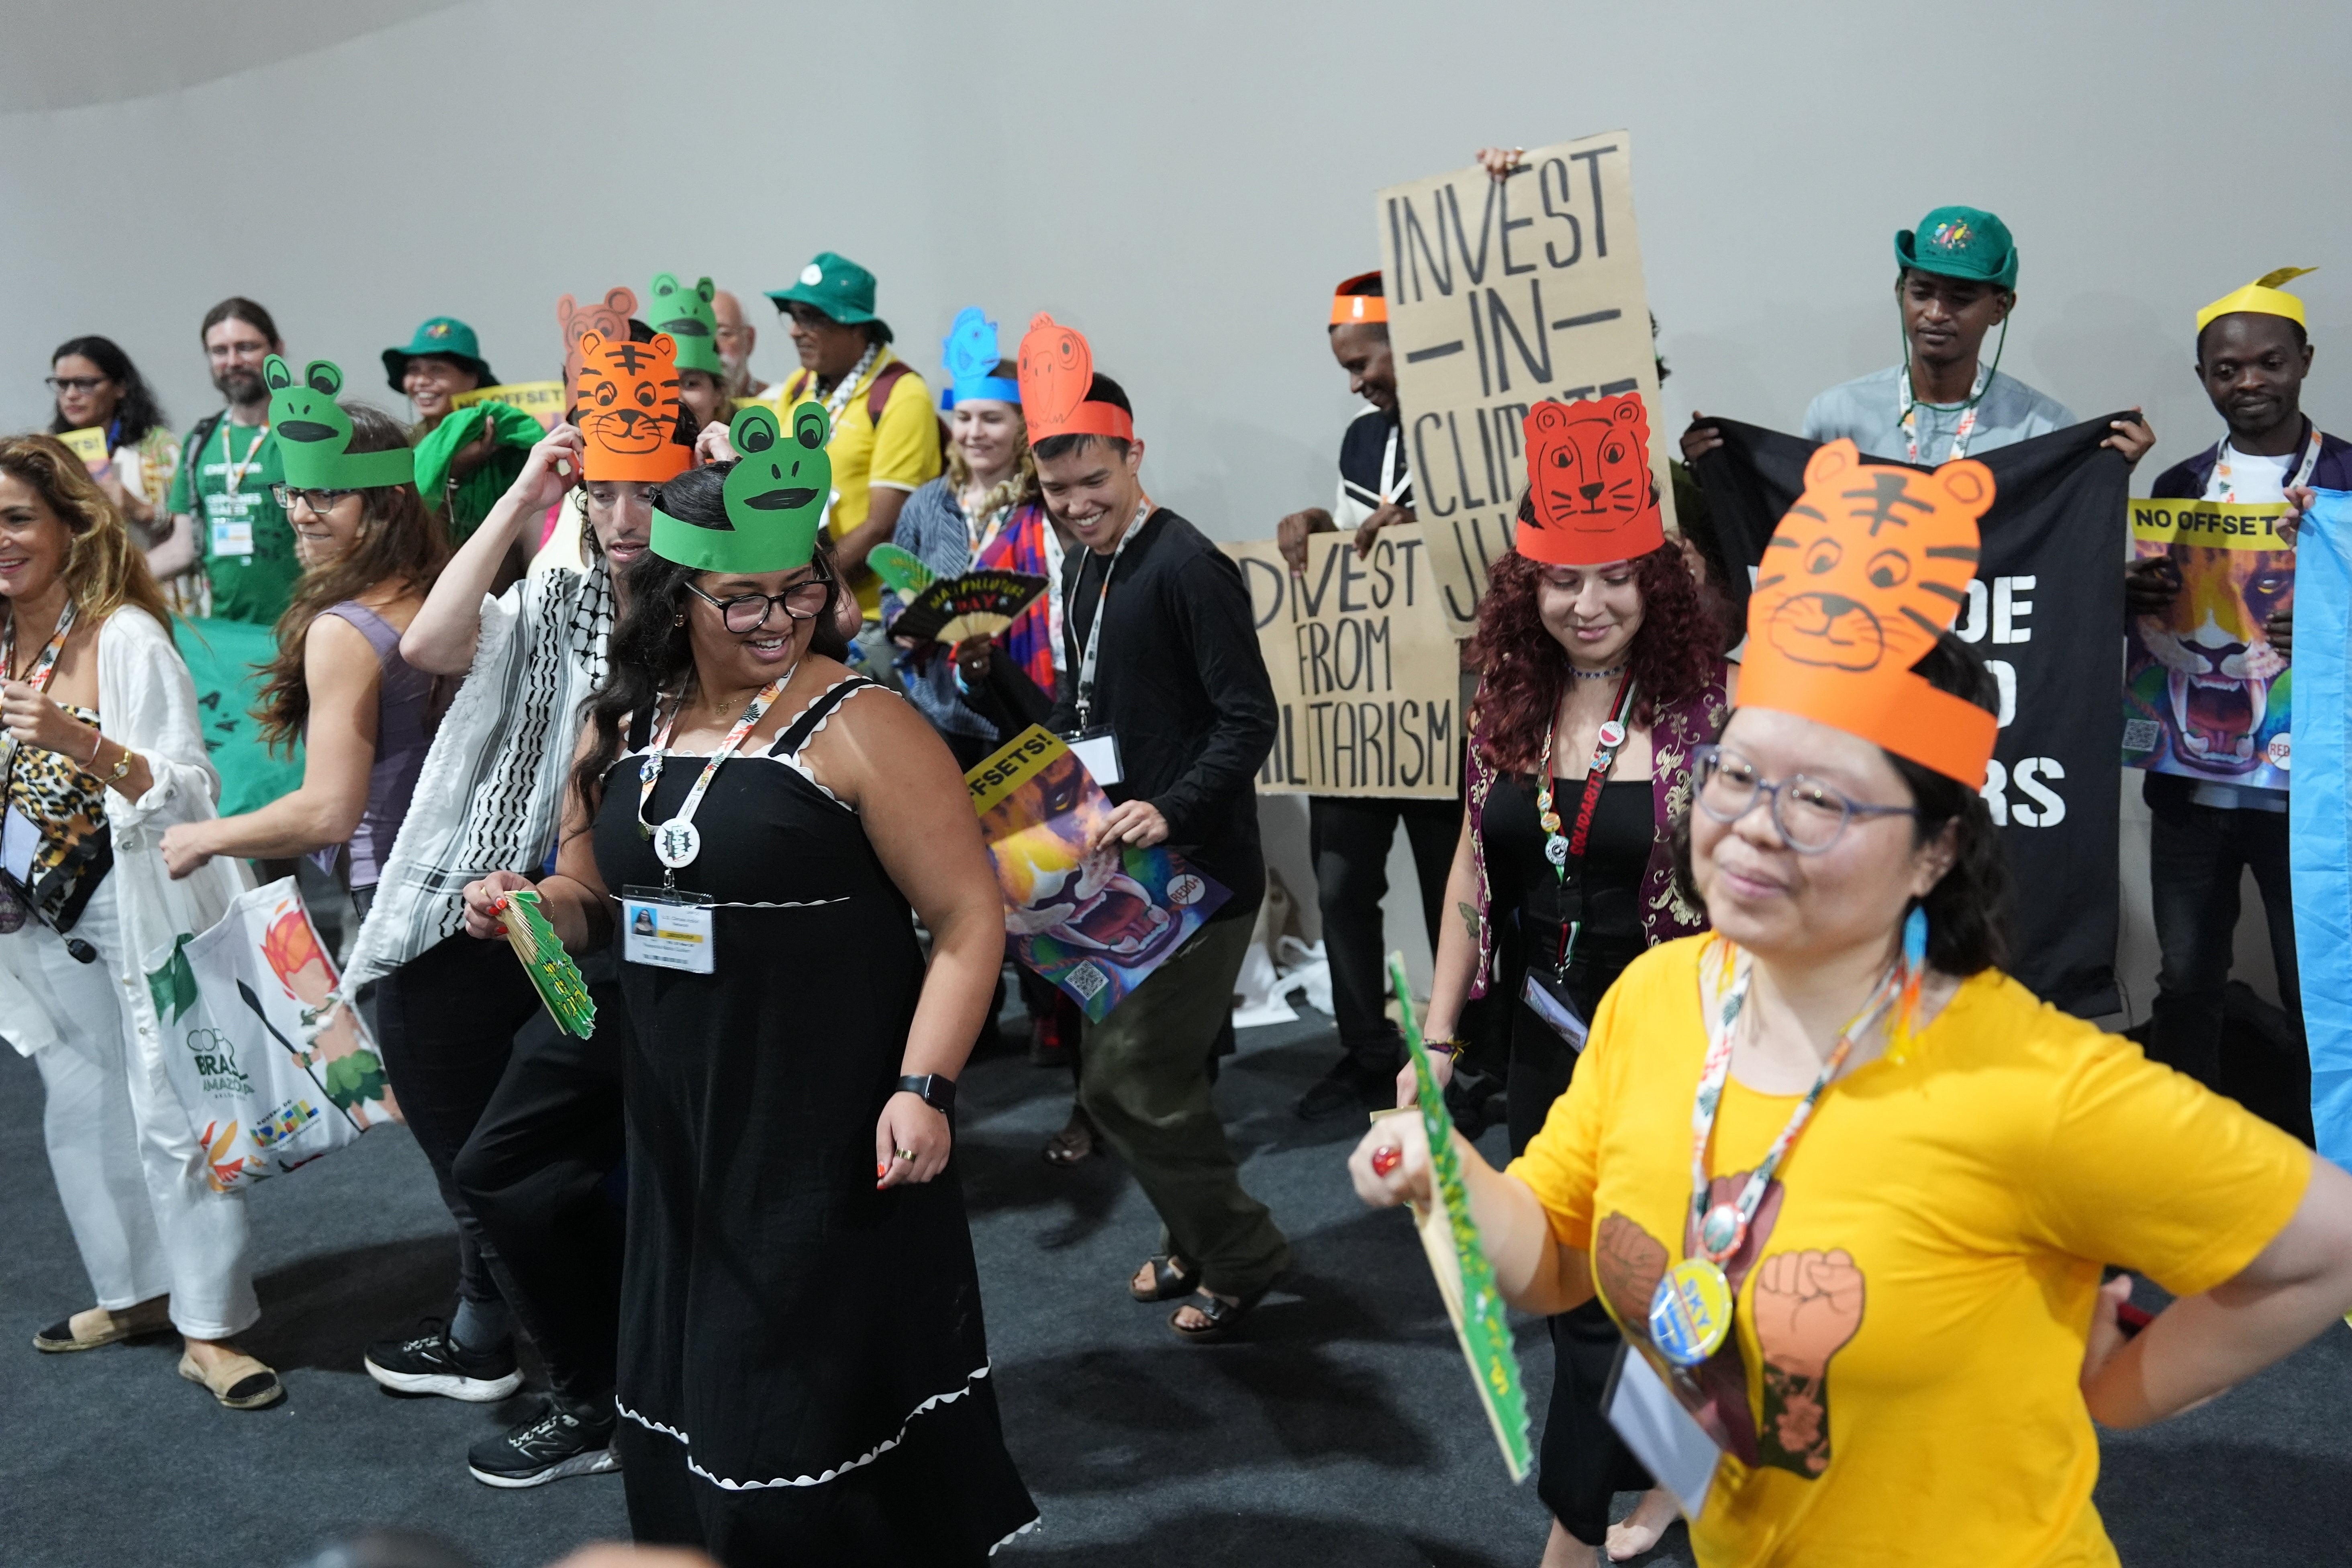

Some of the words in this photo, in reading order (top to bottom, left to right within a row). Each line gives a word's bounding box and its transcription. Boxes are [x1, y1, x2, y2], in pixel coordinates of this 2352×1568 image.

[1388, 145, 1617, 305] INVEST
[1414, 378, 1639, 517] CLIM
[2135, 509, 2172, 528] NO
[2177, 511, 2280, 535] OFFSET
[1240, 539, 1423, 630] DIVEST
[1296, 616, 1392, 696] FROM
[970, 733, 1054, 798] FSETS!
[1261, 699, 1451, 787] ILITARISM
[671, 825, 687, 862] BAM!
